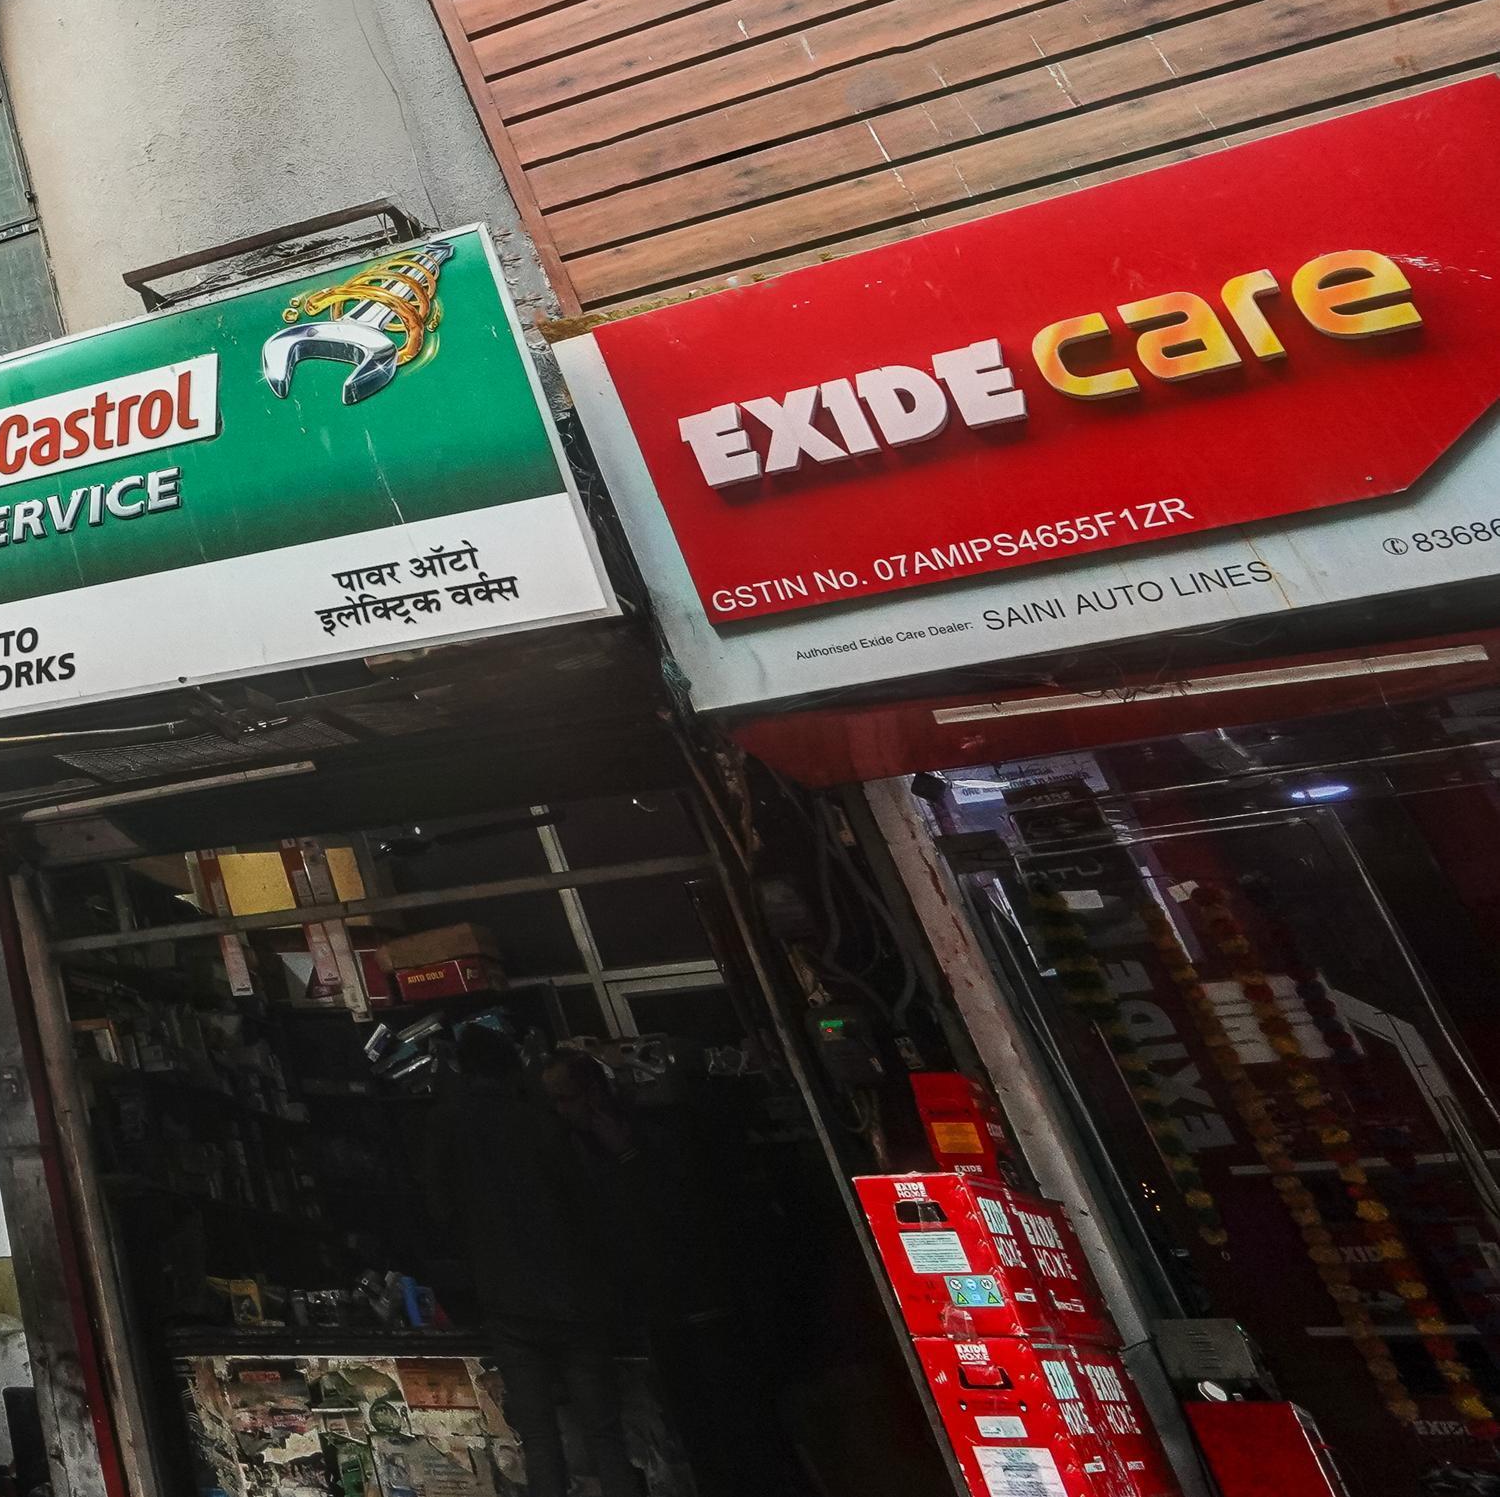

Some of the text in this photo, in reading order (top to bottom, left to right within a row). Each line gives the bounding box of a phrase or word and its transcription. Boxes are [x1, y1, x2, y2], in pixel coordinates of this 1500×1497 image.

[679, 248, 1424, 489] EXIDE care
[331, 540, 479, 592] पावर ऑटो
[711, 495, 1195, 618] GSTIN No. 07AMIPS4655F1ZR
[445, 572, 520, 607] वर्क्स
[796, 559, 1276, 660] Authorised Exide Care Dealer: SAINI AUTO LINES
[407, 971, 445, 984] AUTO GOLD
[977, 1195, 1013, 1236] EXIDE
[1017, 1210, 1064, 1250] EXIDE
[1041, 1360, 1079, 1400] EXIDE
[1086, 1364, 1127, 1402] EXIDE
